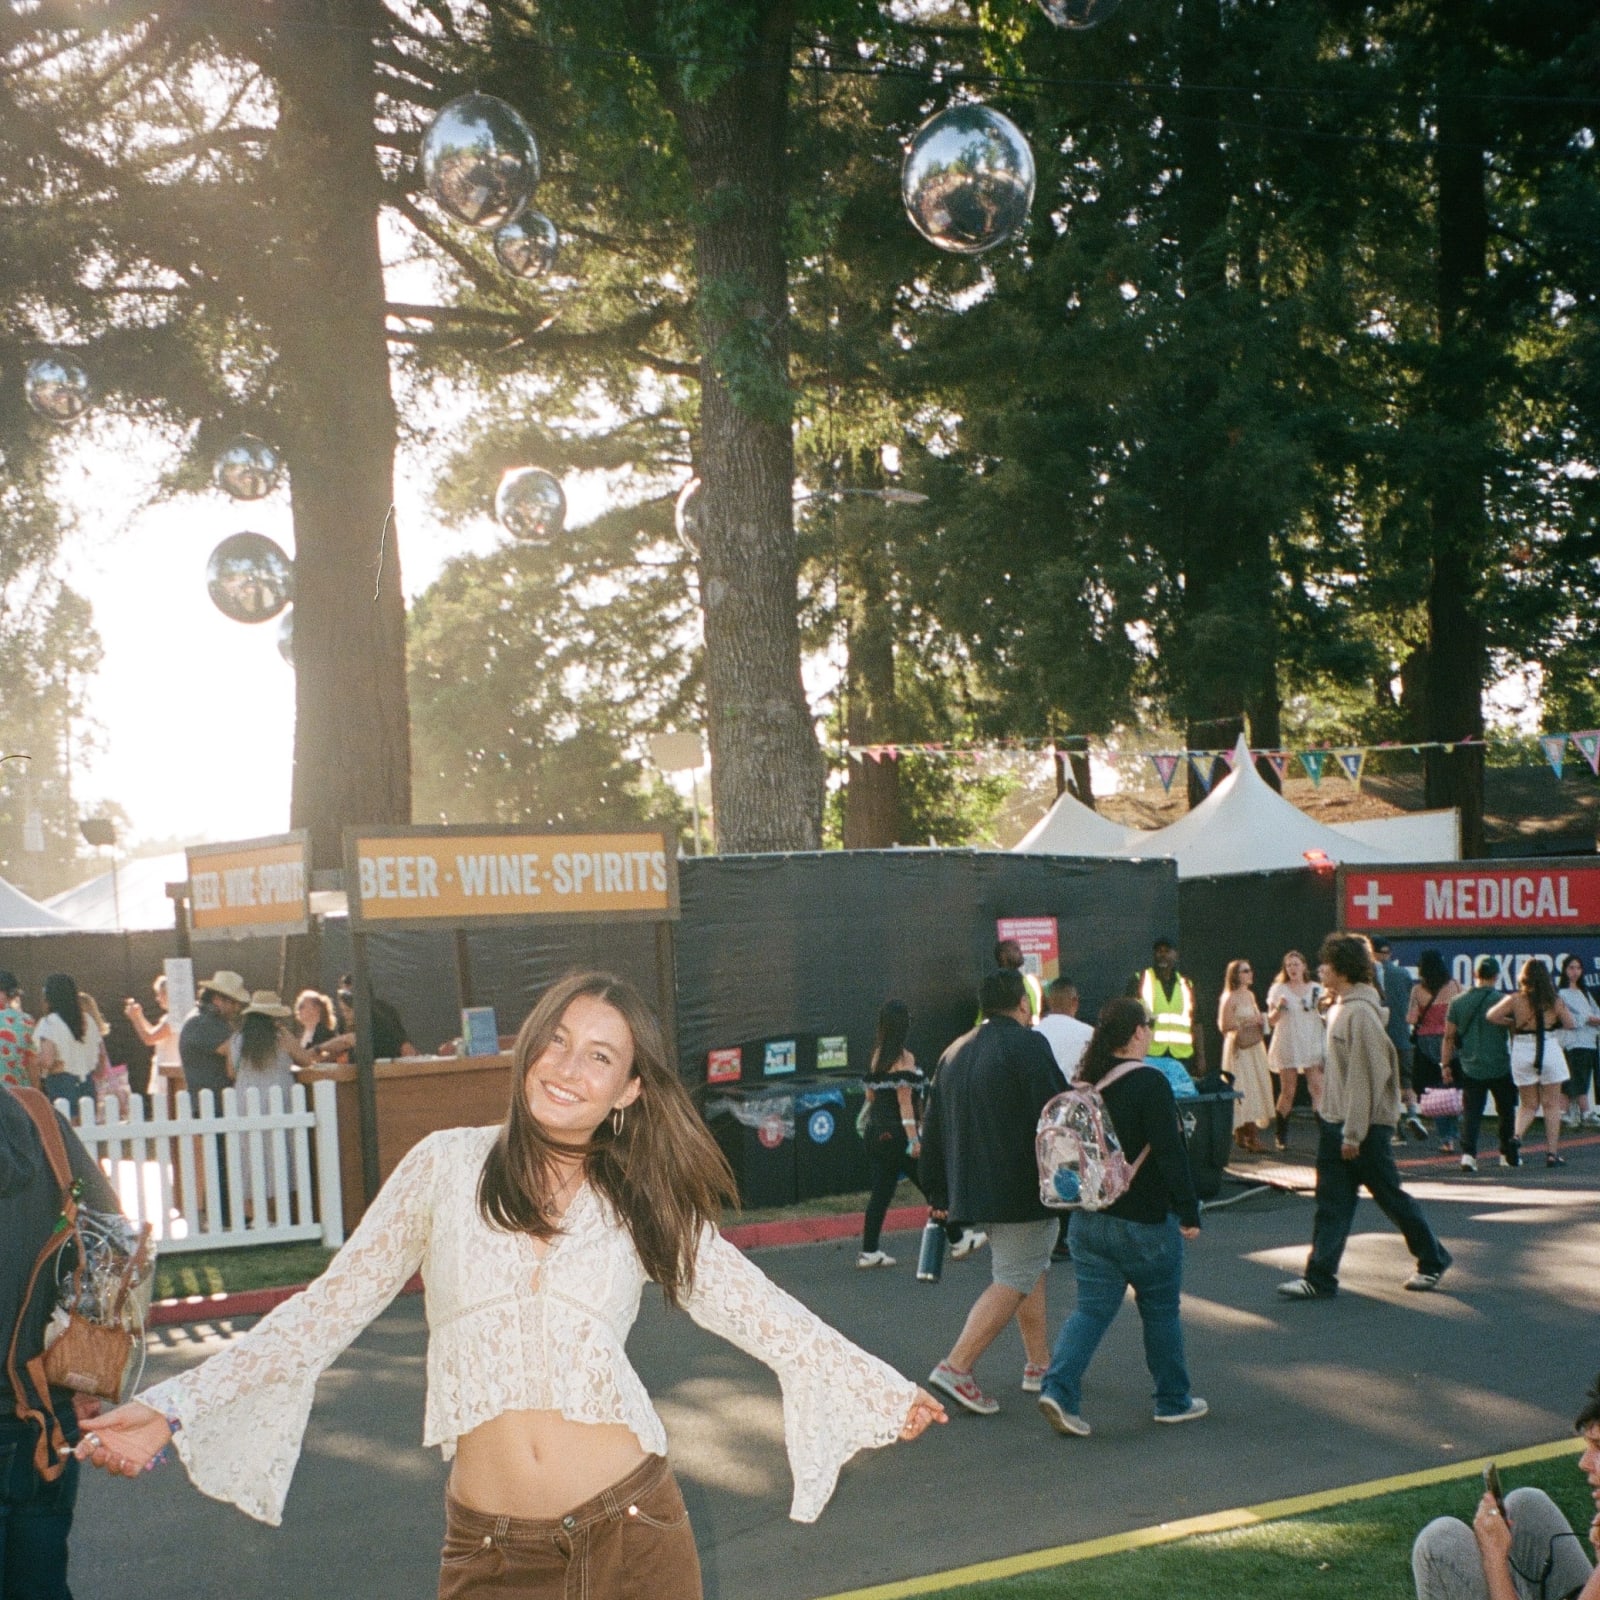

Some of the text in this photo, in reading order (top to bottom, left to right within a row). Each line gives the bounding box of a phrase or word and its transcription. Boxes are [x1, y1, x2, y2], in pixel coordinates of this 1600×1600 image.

[358, 851, 667, 899] BEER WINE SPIRITS
[1424, 876, 1578, 920] MEDICAL
